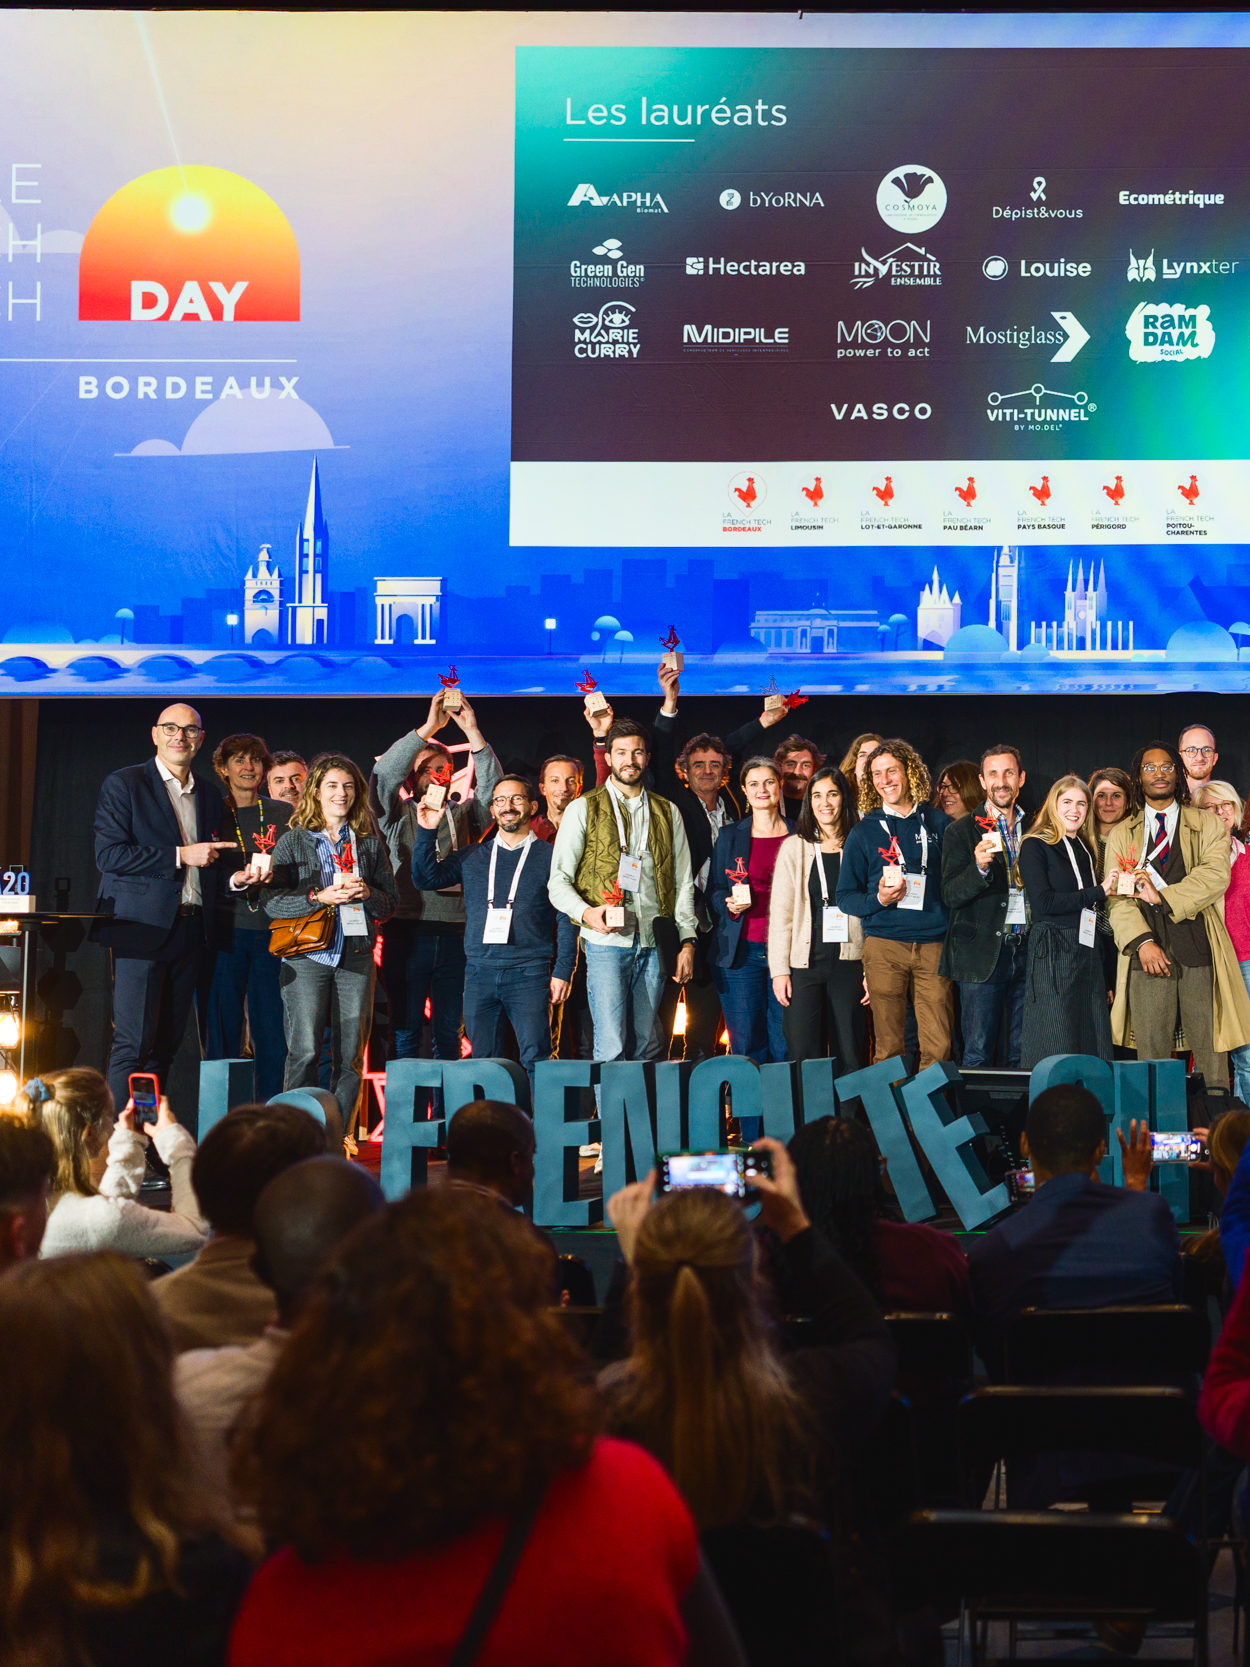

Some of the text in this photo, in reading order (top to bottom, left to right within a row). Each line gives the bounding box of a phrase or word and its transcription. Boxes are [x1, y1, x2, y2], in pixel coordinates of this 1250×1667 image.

[565, 96, 788, 126] Les lauréats
[749, 191, 825, 207] bYoRNA
[1118, 190, 1225, 208] Ecométrique
[885, 203, 937, 212] COSMOYA
[992, 205, 1084, 221] Dépist&vous
[570, 260, 645, 276] Green Gen
[708, 257, 806, 275] Hectarea
[854, 258, 942, 278] INVESTIR
[1020, 259, 1092, 277] Louise
[1162, 258, 1240, 279] Lynxter
[570, 277, 641, 288] TECHNOLOGIES
[891, 277, 942, 285] ENSEMBLE
[130, 281, 249, 321] DAY
[574, 328, 639, 343] MARIE
[837, 319, 930, 343] MOON
[966, 326, 1064, 348] Mostiglass
[1143, 331, 1199, 347] DAM
[574, 344, 641, 358] CURRY
[837, 347, 930, 358] power to act
[1160, 348, 1184, 356] SOCIAL
[79, 375, 300, 400] BORDEAUX
[830, 403, 932, 420] VASCO
